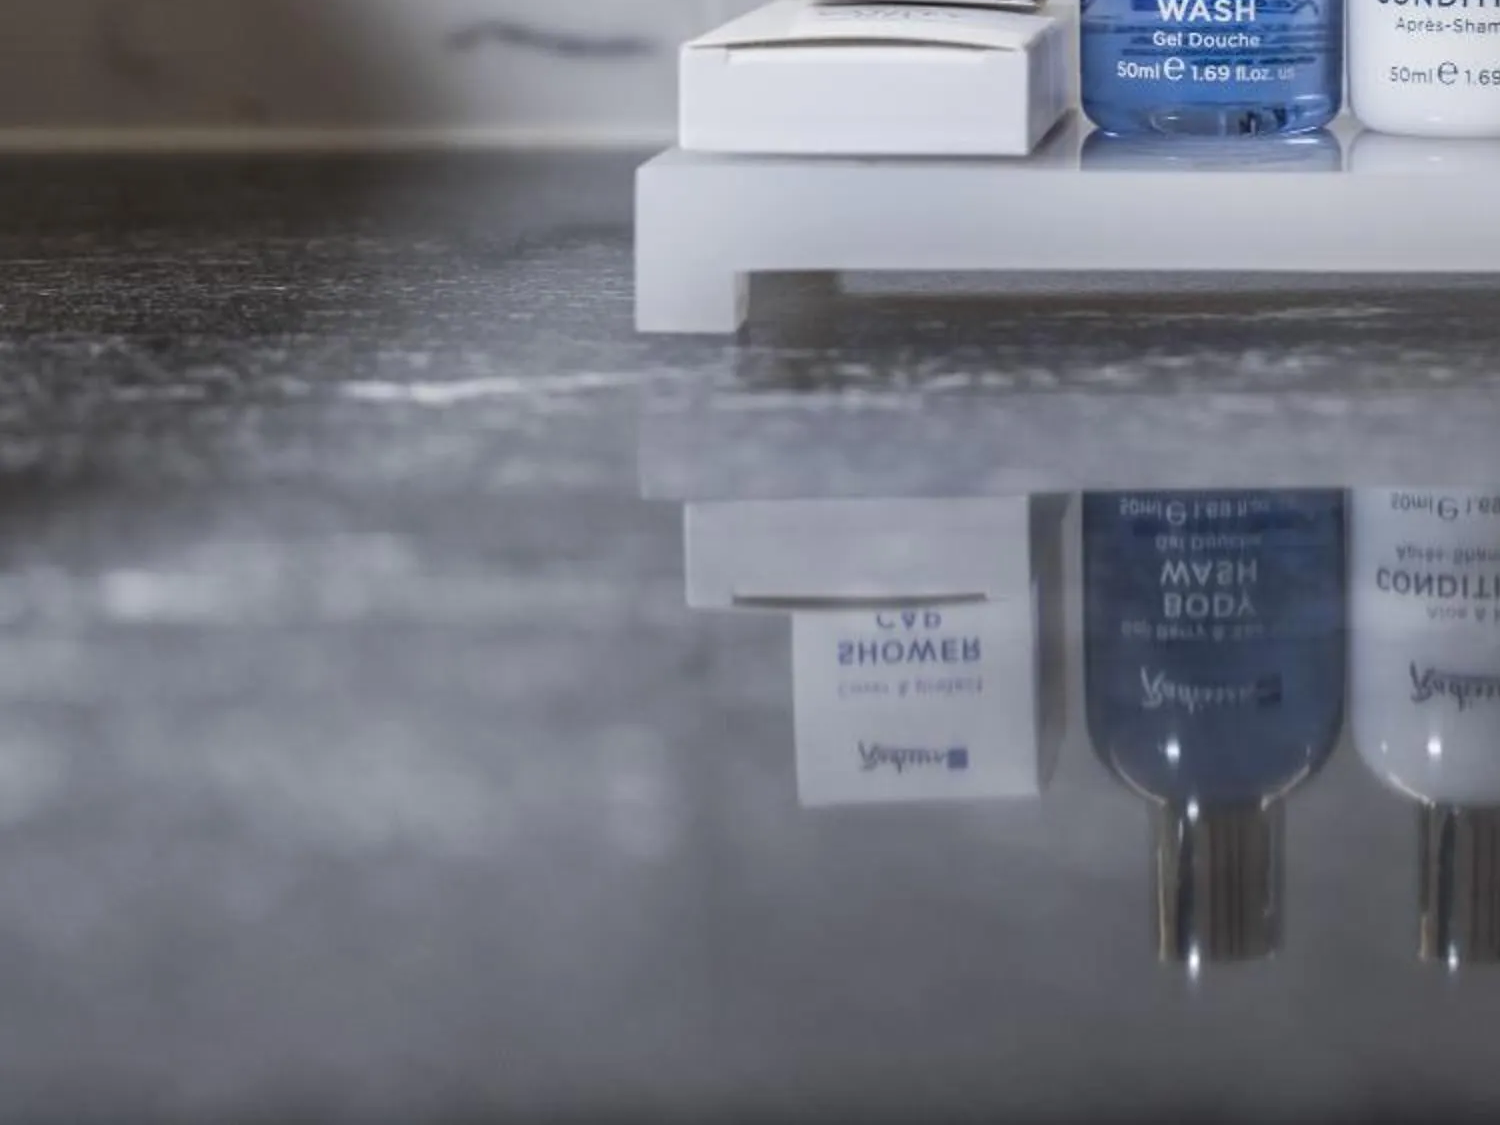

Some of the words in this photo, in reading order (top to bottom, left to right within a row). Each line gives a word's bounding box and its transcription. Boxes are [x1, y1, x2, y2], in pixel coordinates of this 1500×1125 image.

[1153, 31, 1182, 47] Gel
[1188, 32, 1261, 48] Douche
[1117, 60, 1160, 79] 50ml
[1191, 64, 1230, 82] 1.69
[1390, 66, 1433, 84] 50ml
